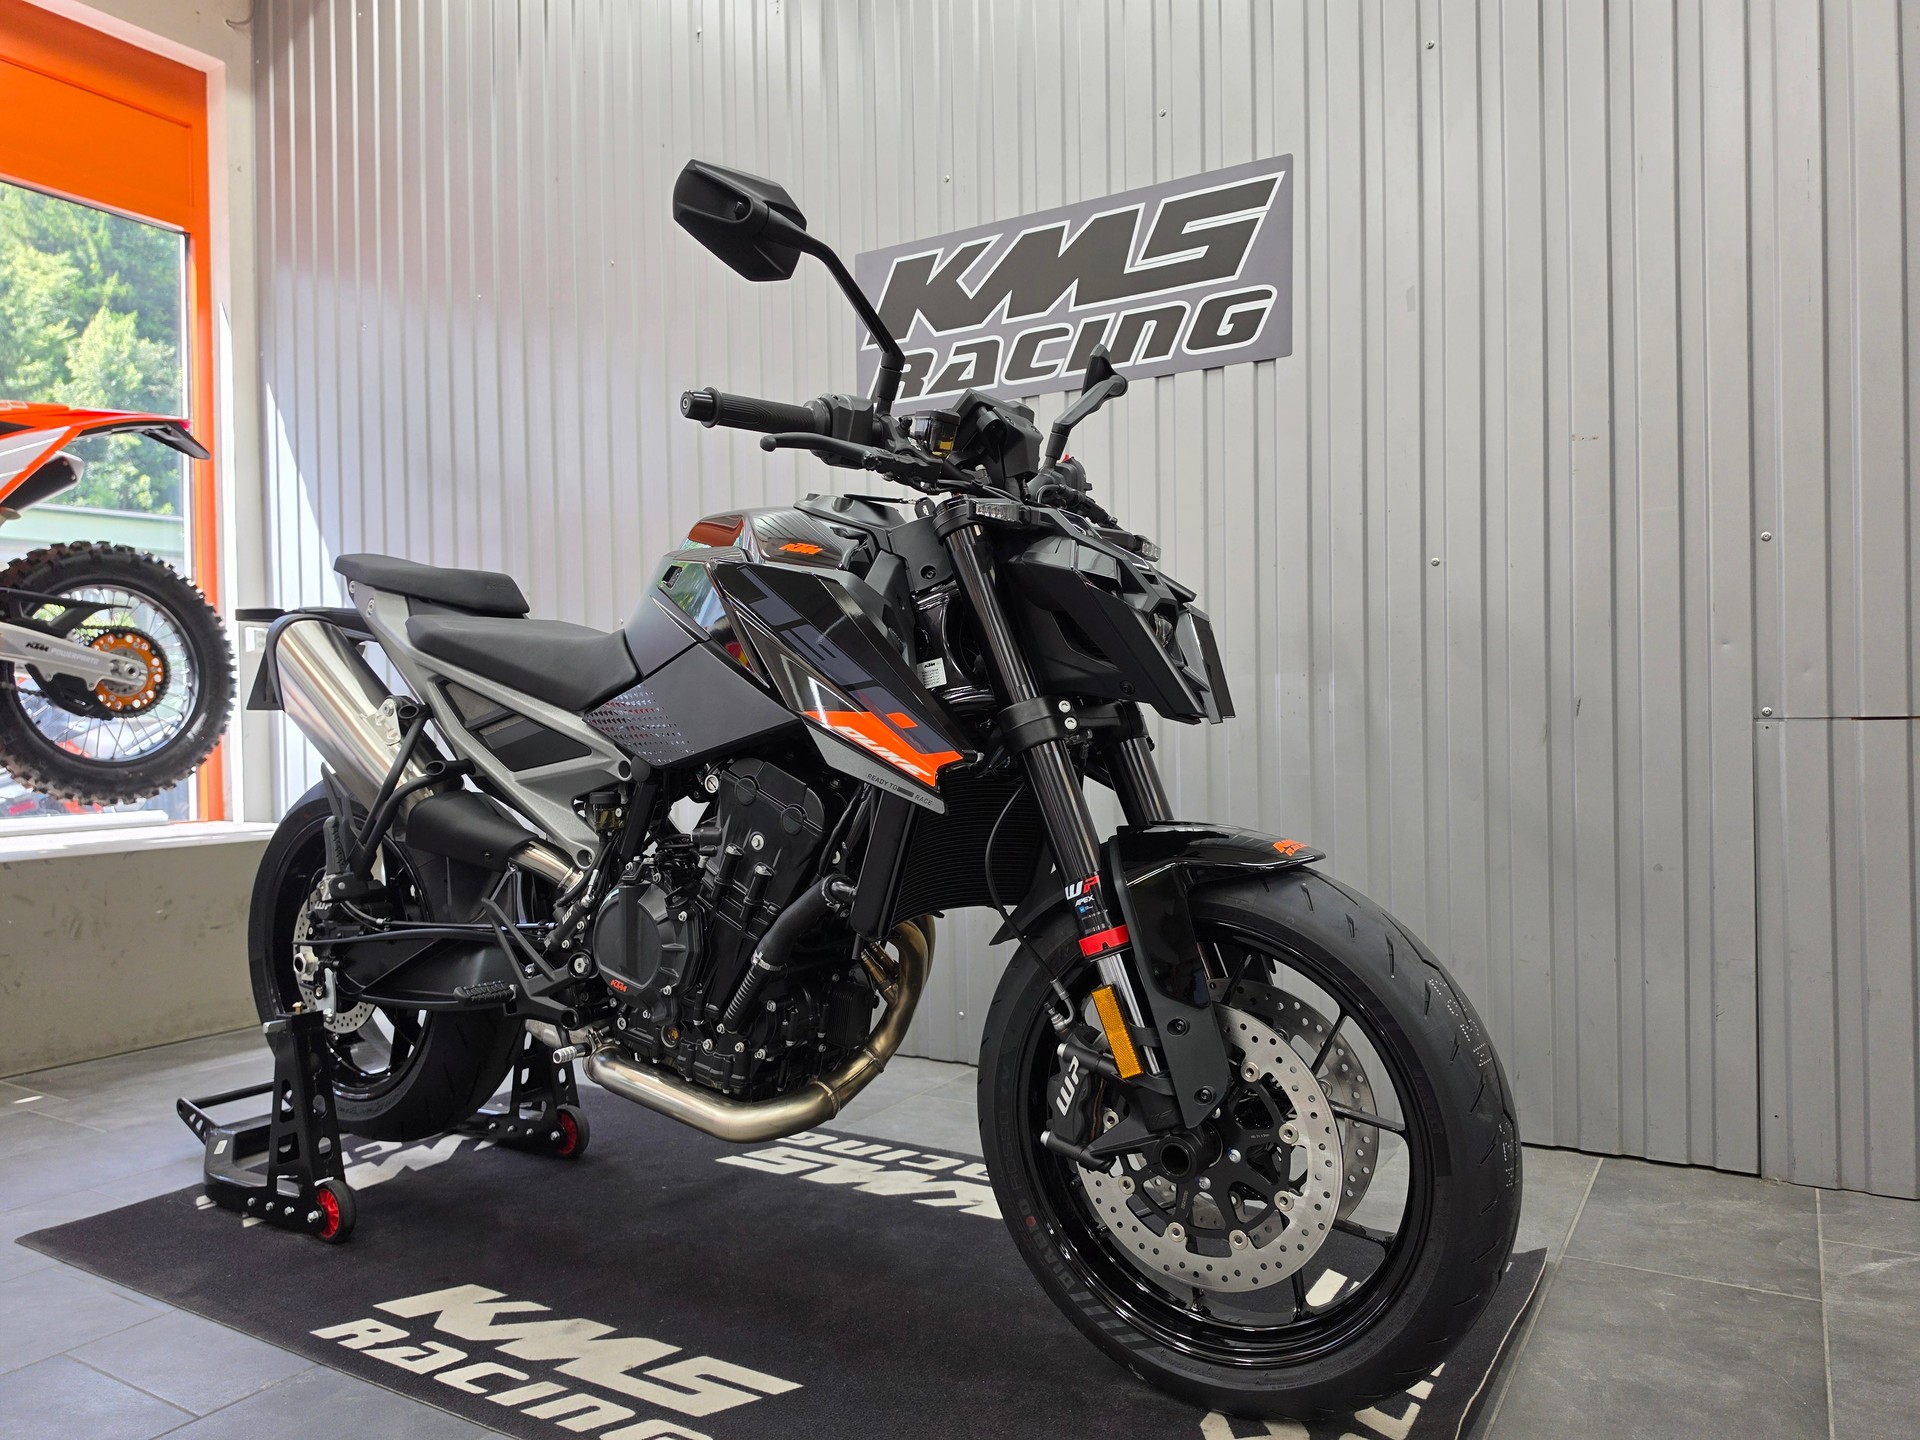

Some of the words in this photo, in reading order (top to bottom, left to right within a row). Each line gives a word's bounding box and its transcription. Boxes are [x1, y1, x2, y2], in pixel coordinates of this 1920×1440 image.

[861, 171, 1286, 352] KMS
[25, 641, 50, 652] KTM
[831, 725, 933, 777] DUKE
[866, 773, 889, 787] READY
[889, 782, 899, 791] TO
[914, 794, 933, 806] RACE
[1064, 875, 1100, 900] WP
[1074, 894, 1095, 908] APEX
[610, 979, 628, 993] KTM
[1056, 1055, 1079, 1117] WP
[372, 1283, 804, 1417] KMS
